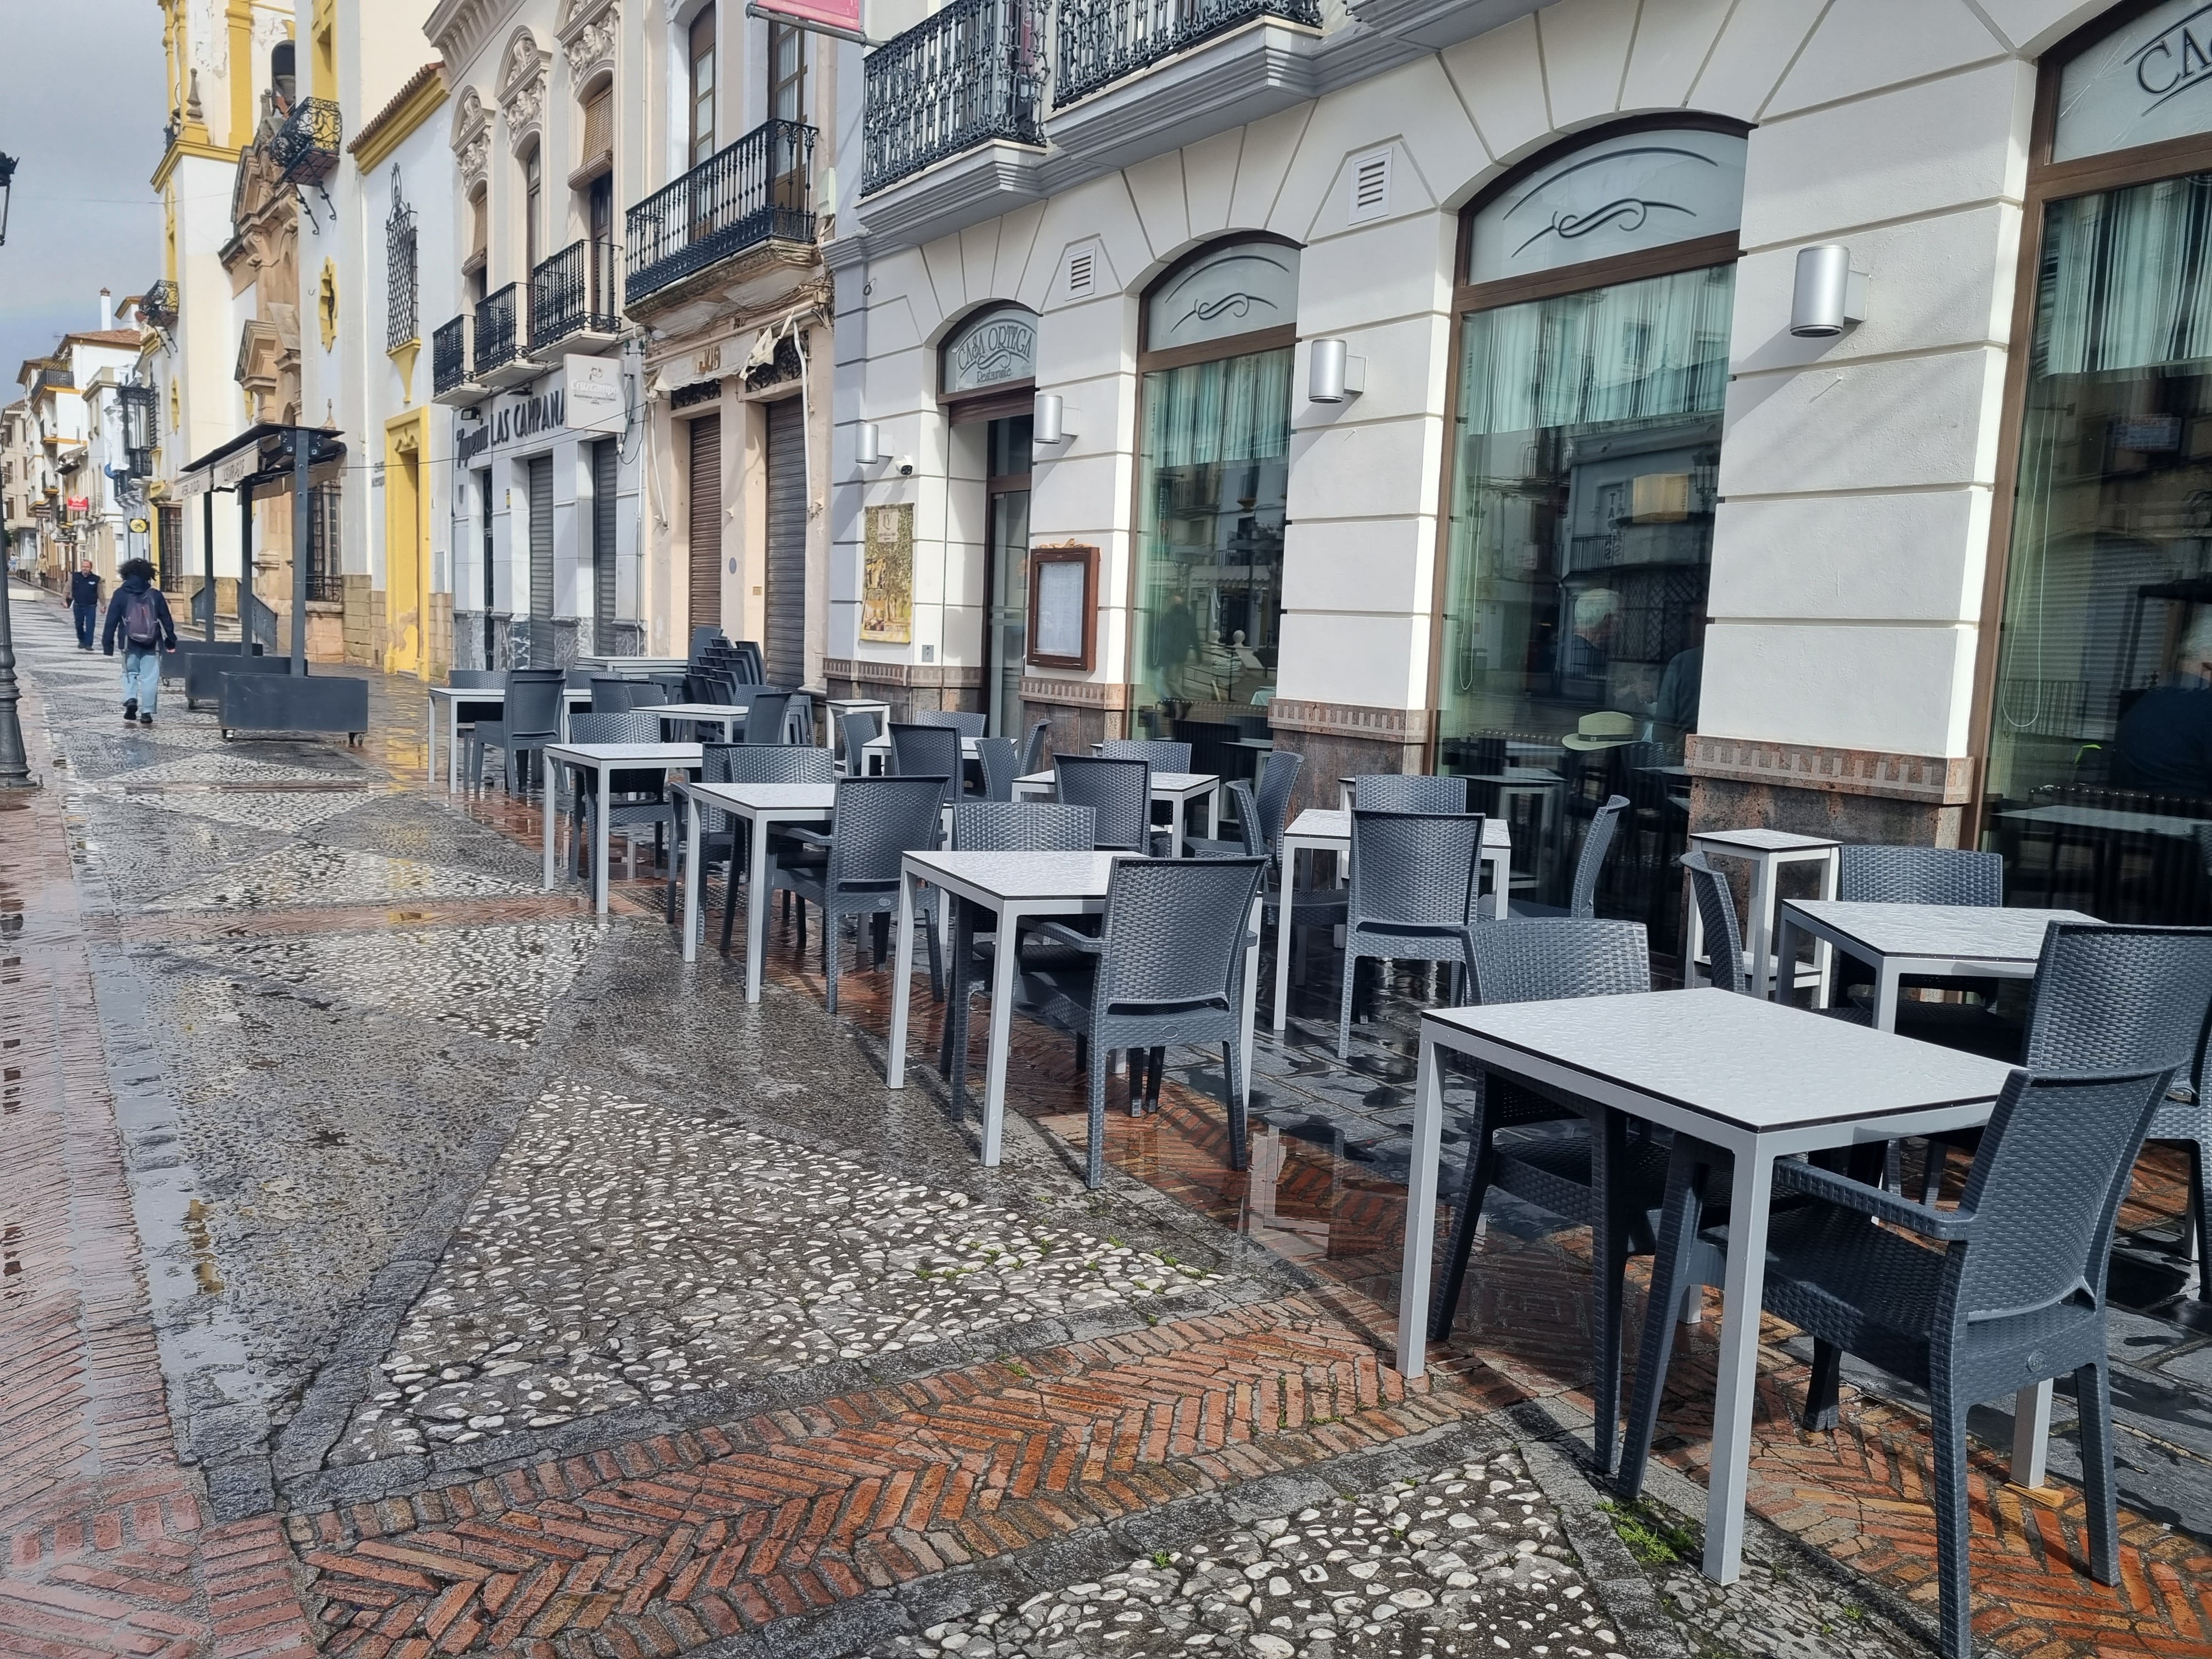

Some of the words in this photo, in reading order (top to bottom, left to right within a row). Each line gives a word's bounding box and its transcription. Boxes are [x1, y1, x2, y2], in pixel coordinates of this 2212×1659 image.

[2137, 26, 2212, 95] CA
[958, 332, 985, 370] CASA
[988, 325, 1033, 358] ORTEGA
[491, 408, 510, 446] LAS
